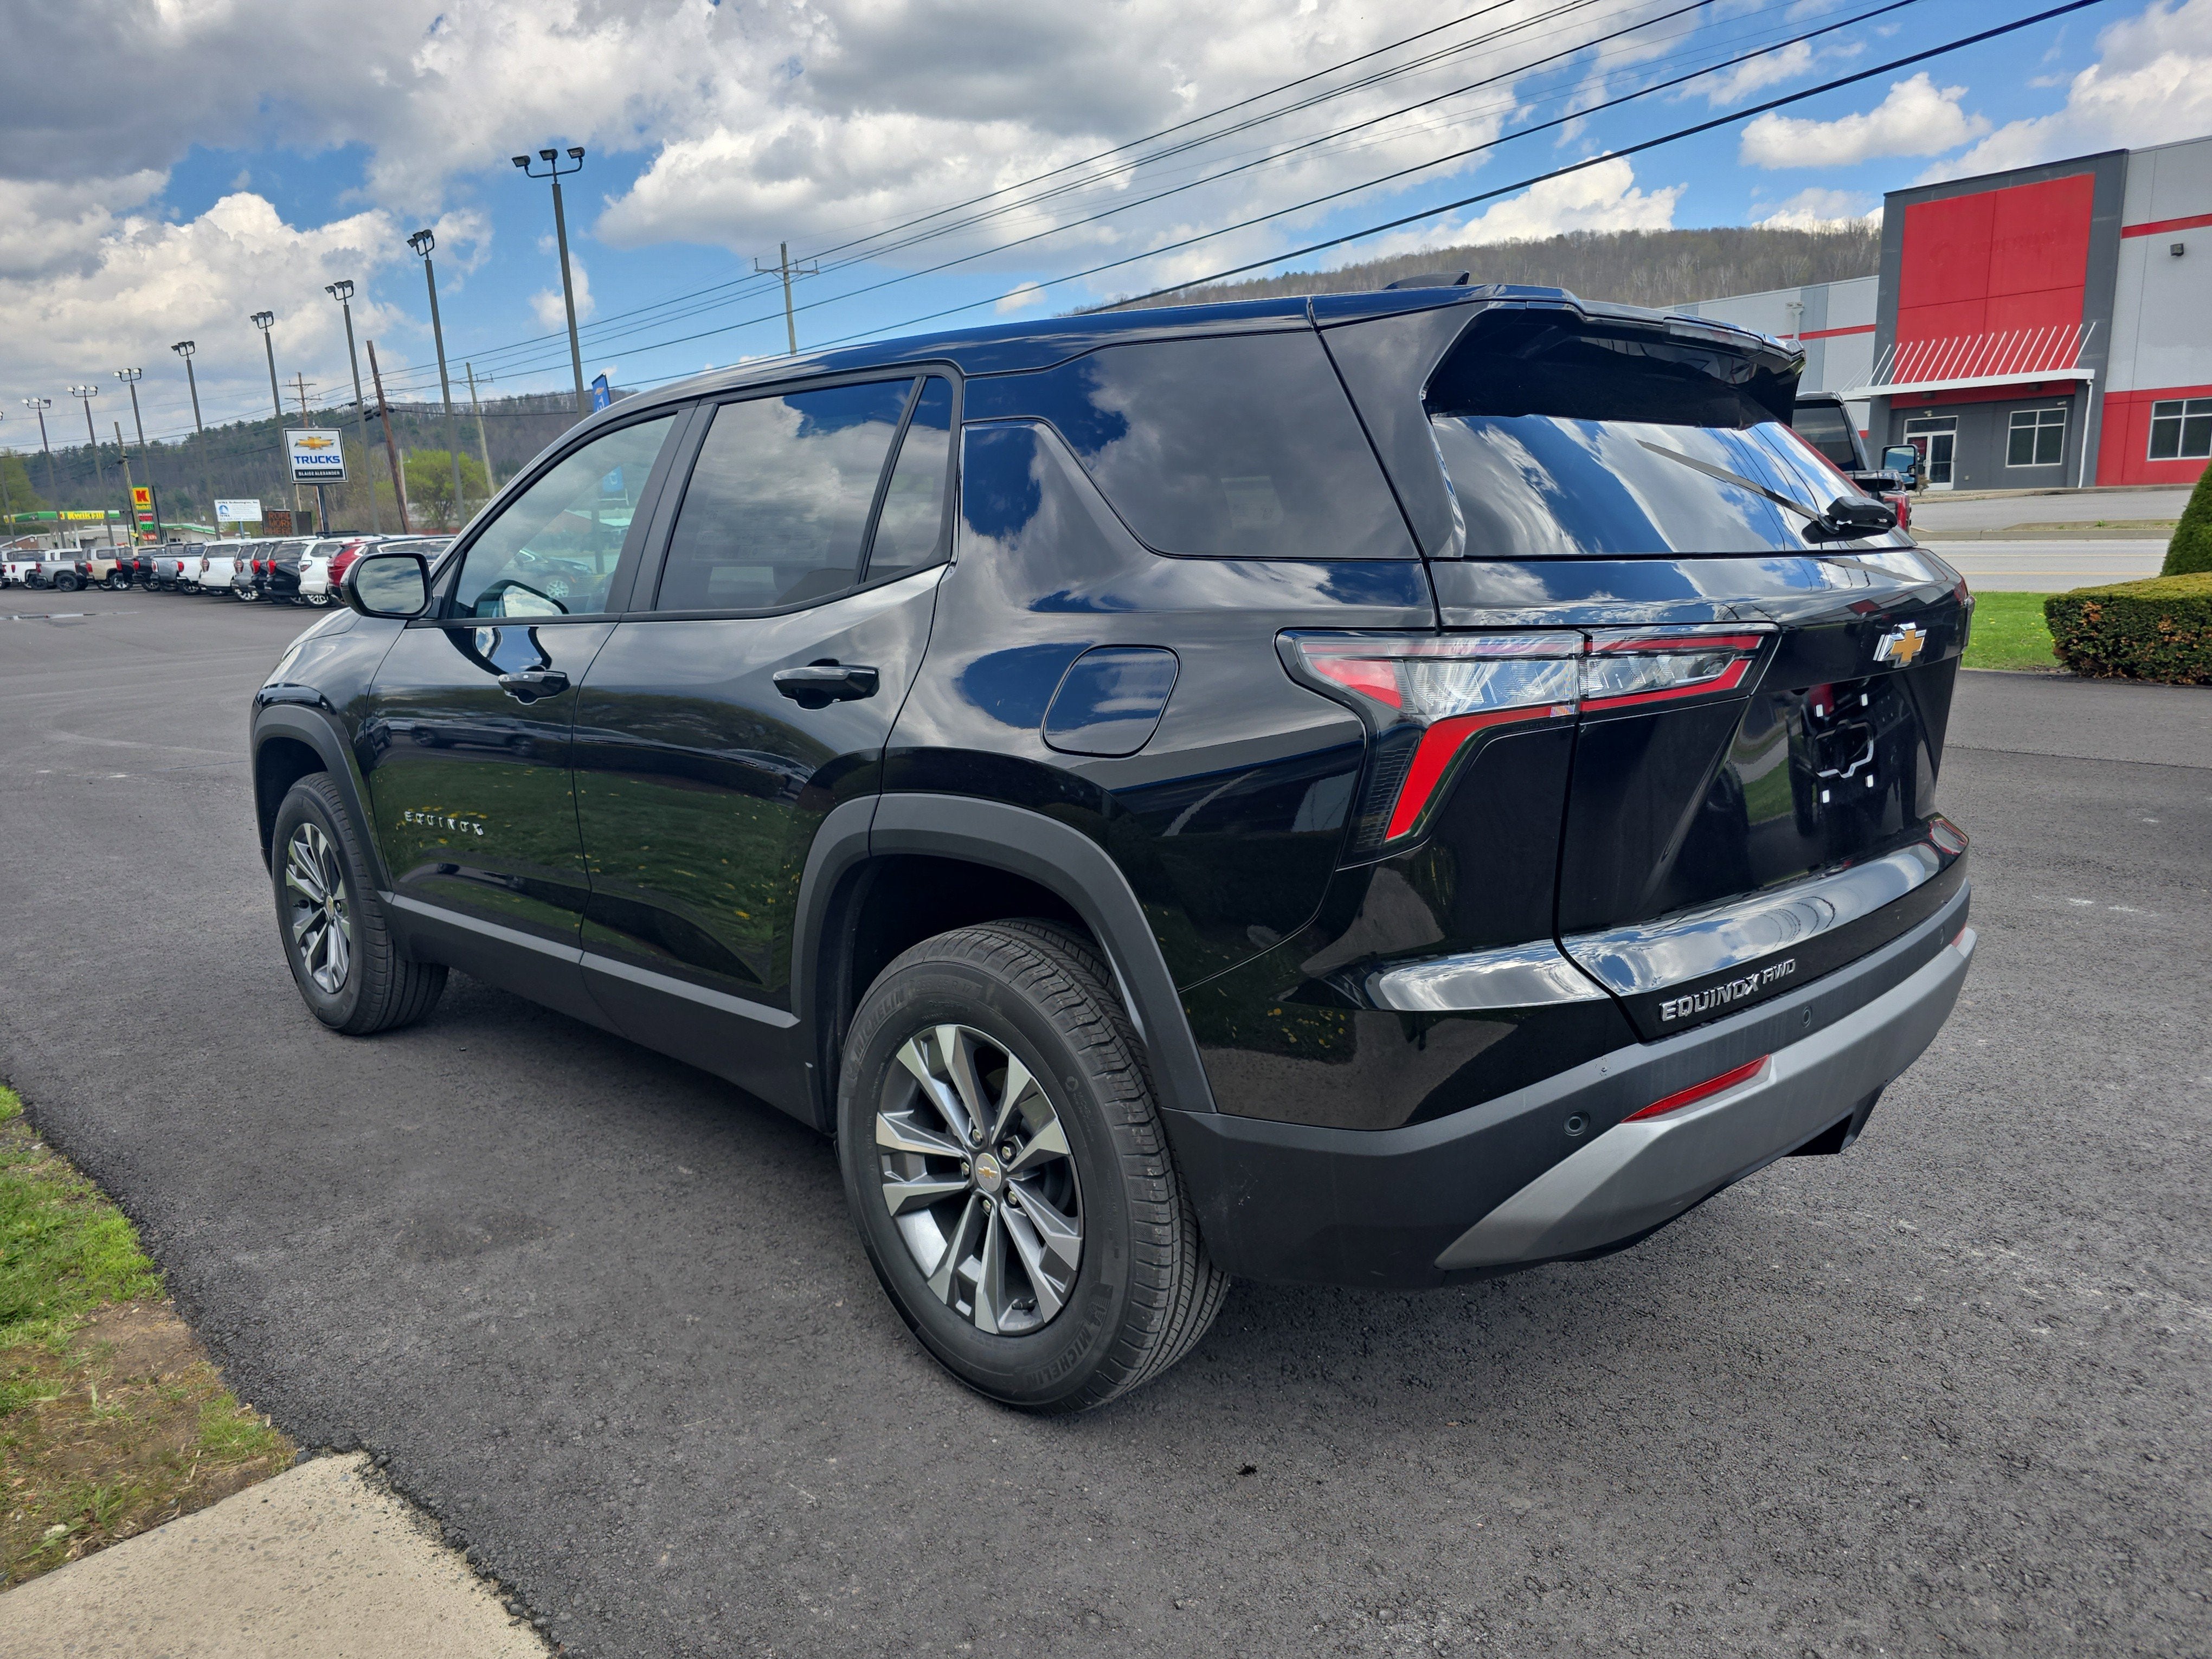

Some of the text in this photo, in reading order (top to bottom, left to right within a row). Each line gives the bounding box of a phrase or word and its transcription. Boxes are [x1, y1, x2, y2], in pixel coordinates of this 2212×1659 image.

[294, 455, 340, 464] TRUCKS
[136, 490, 149, 502] K
[264, 527, 293, 535] AHEAD
[404, 811, 484, 835] EQUINOX
[1659, 958, 1796, 1022] EQUINOX AWD
[853, 988, 904, 1059] MICHELIN
[1026, 1326, 1092, 1384] MICHELIN
